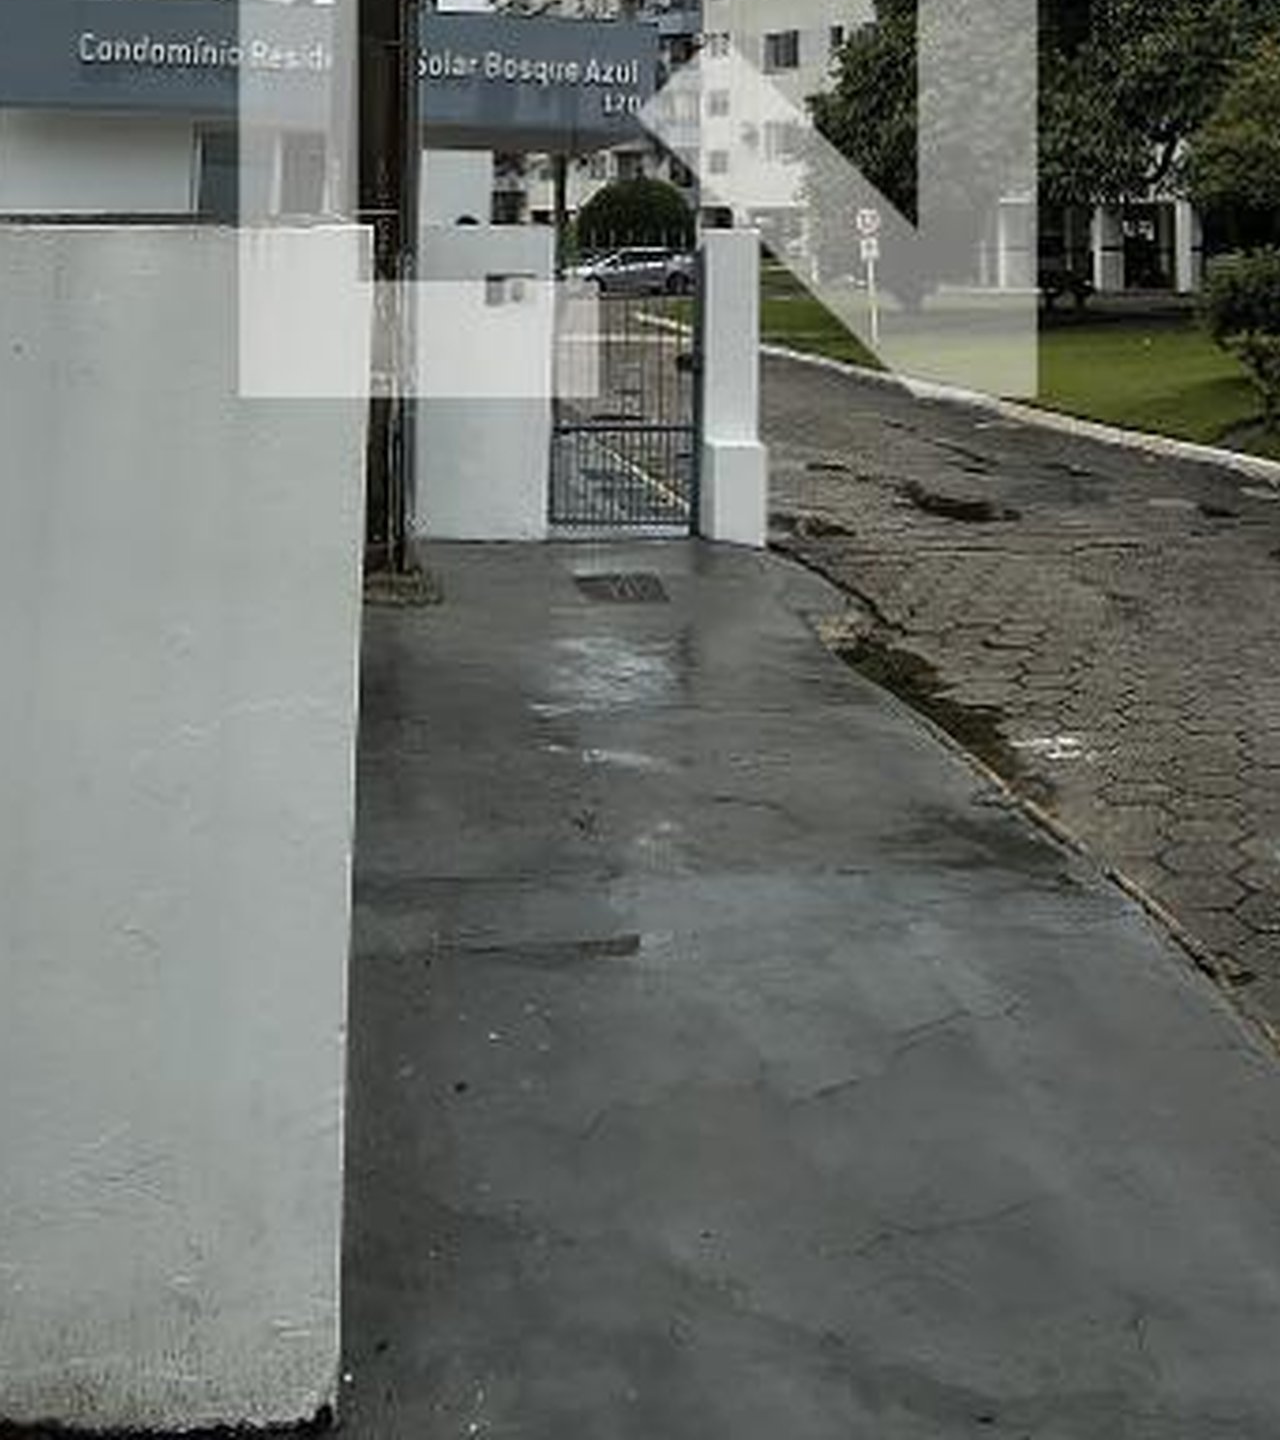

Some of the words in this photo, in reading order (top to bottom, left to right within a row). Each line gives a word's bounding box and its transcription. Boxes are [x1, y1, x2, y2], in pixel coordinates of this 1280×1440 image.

[78, 32, 244, 67] Condomínio
[484, 50, 579, 86] Bosque
[582, 59, 638, 84] Azul
